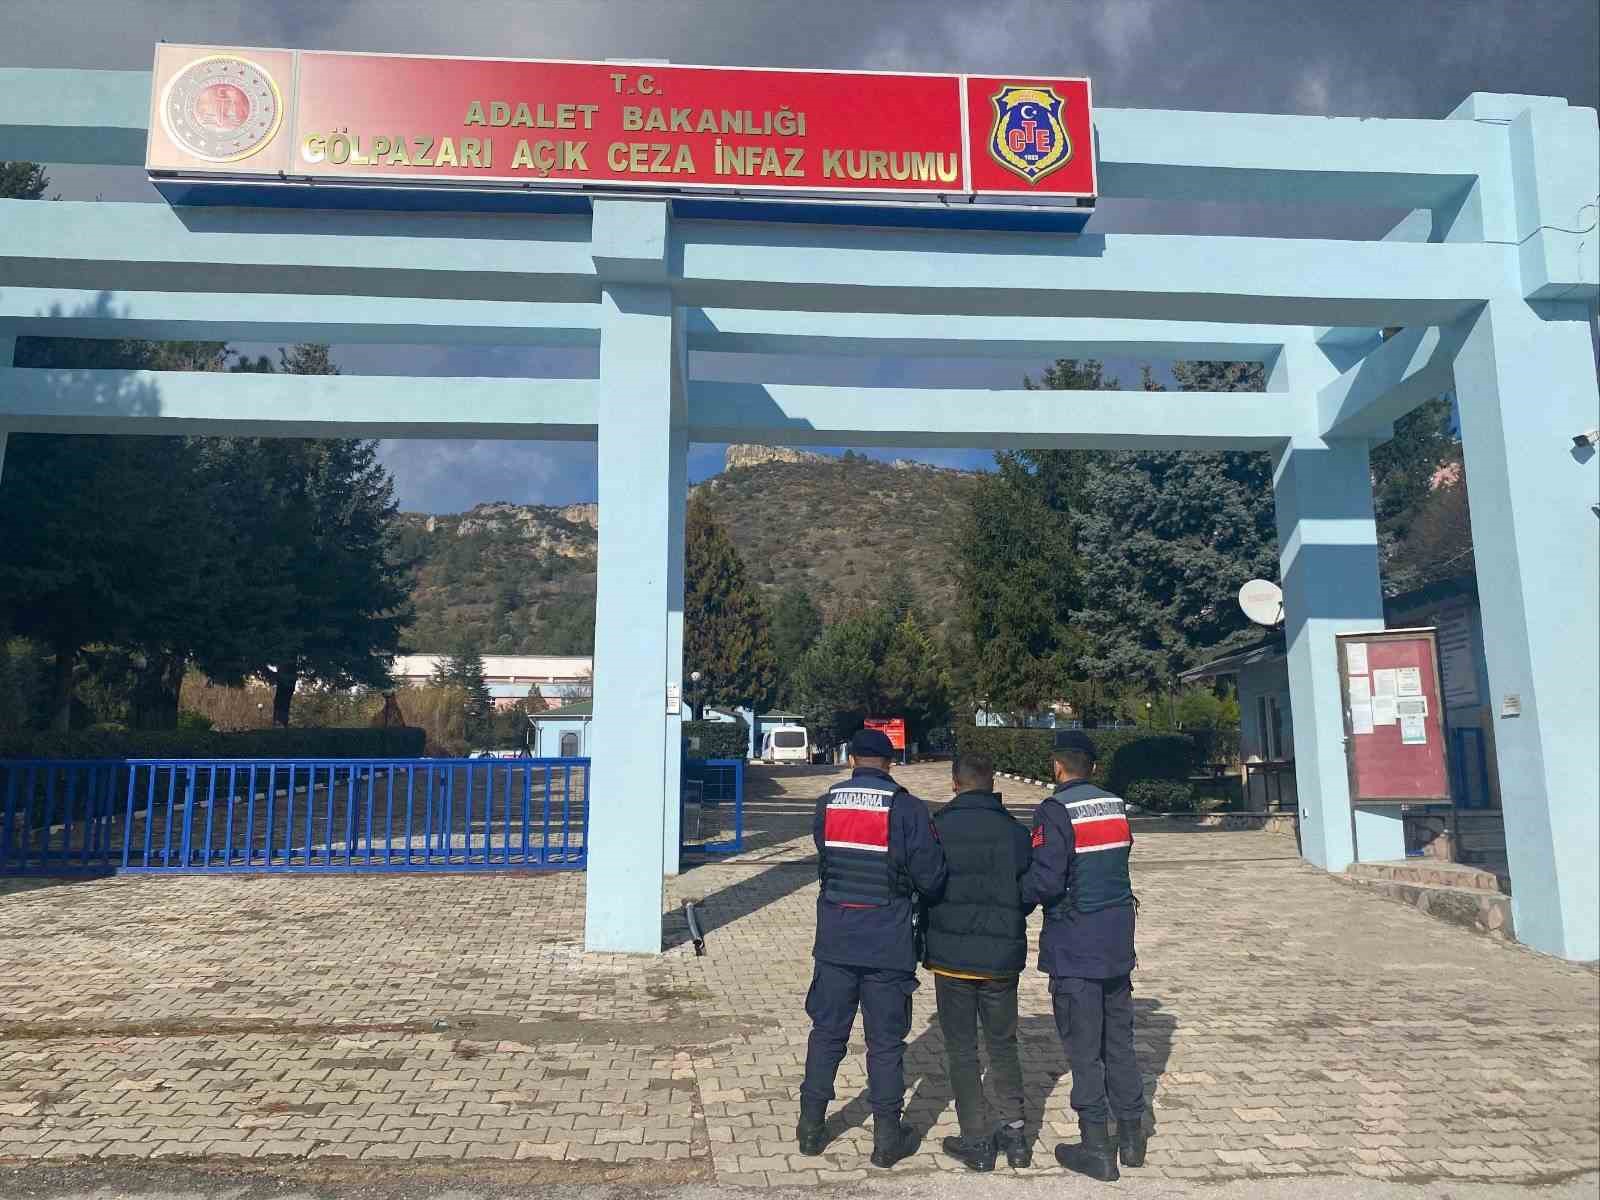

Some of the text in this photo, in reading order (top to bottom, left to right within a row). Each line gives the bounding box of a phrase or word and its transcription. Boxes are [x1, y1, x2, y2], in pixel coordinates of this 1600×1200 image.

[464, 100, 806, 136] ADALET BAKANLIĞI
[1008, 120, 1051, 153] CTE
[302, 127, 958, 182] GÖLPAZARI AÇIK CEZA İNFAZ KURUMU
[832, 792, 883, 807] JANDARMA
